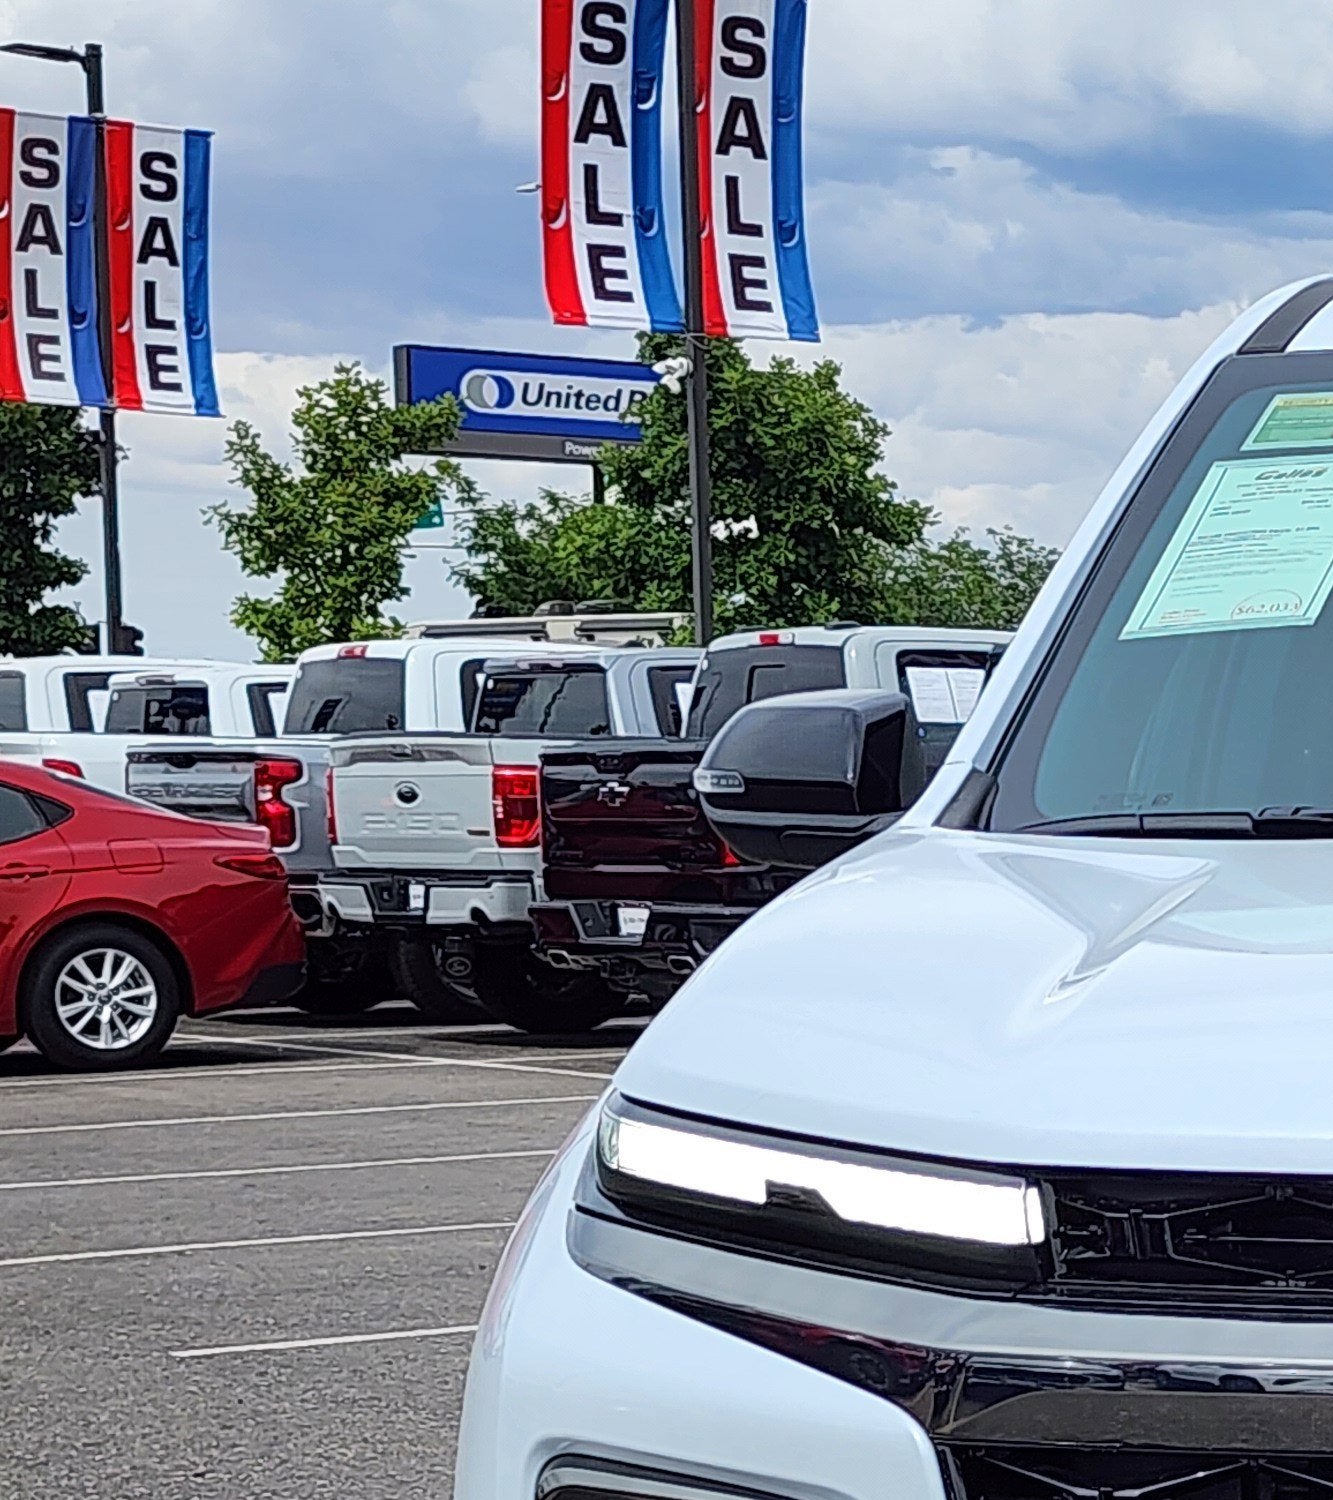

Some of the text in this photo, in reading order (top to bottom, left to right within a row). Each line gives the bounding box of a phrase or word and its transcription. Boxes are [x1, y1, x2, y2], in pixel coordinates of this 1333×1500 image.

[15, 137, 66, 382] SALE
[137, 151, 183, 392] SALE
[573, 1, 635, 303] SALE
[715, 16, 774, 312] SALE
[521, 381, 623, 412] United
